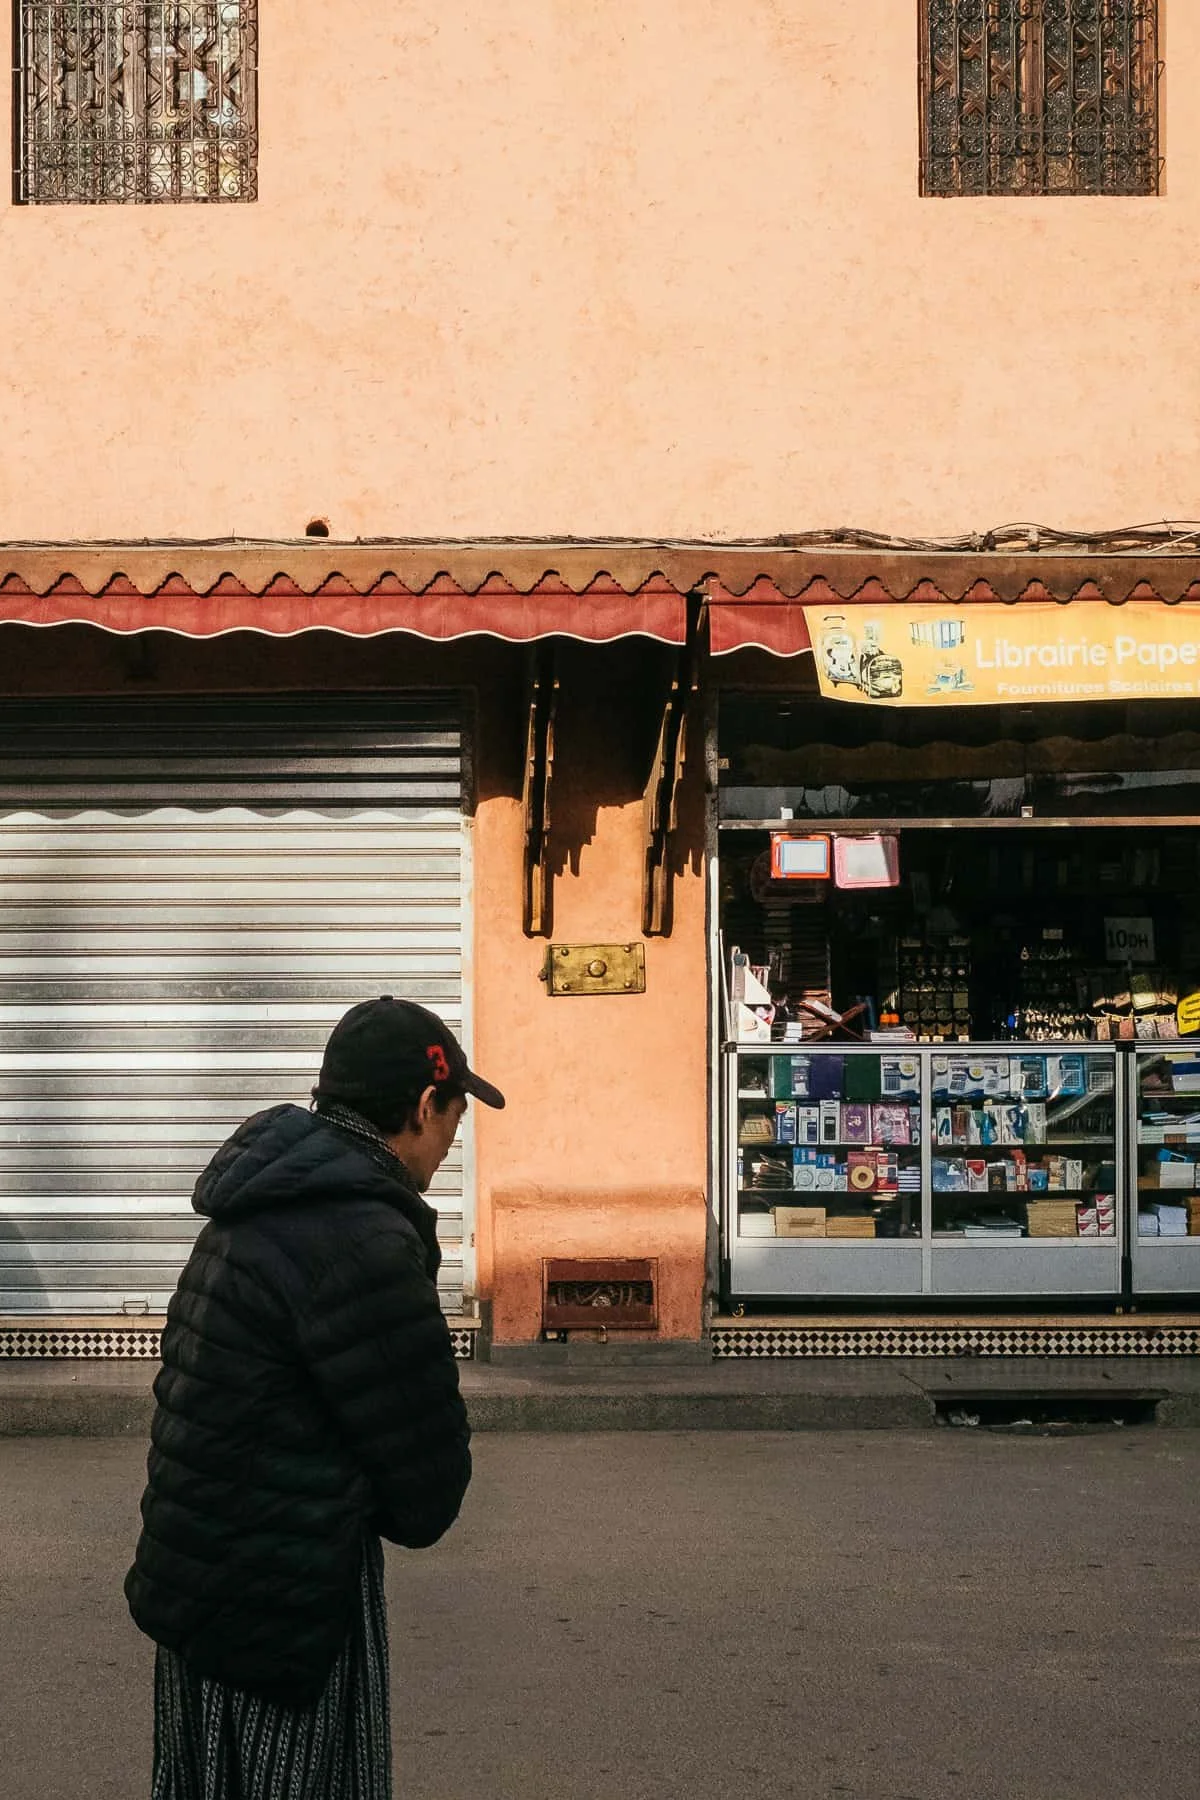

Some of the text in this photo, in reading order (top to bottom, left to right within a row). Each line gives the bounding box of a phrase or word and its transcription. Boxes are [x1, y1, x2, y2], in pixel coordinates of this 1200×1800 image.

[975, 634, 1200, 673] Librairie Pape
[997, 682, 1105, 696] Fournitures
[1108, 679, 1193, 694] Scolaires
[426, 1044, 450, 1081] 3
